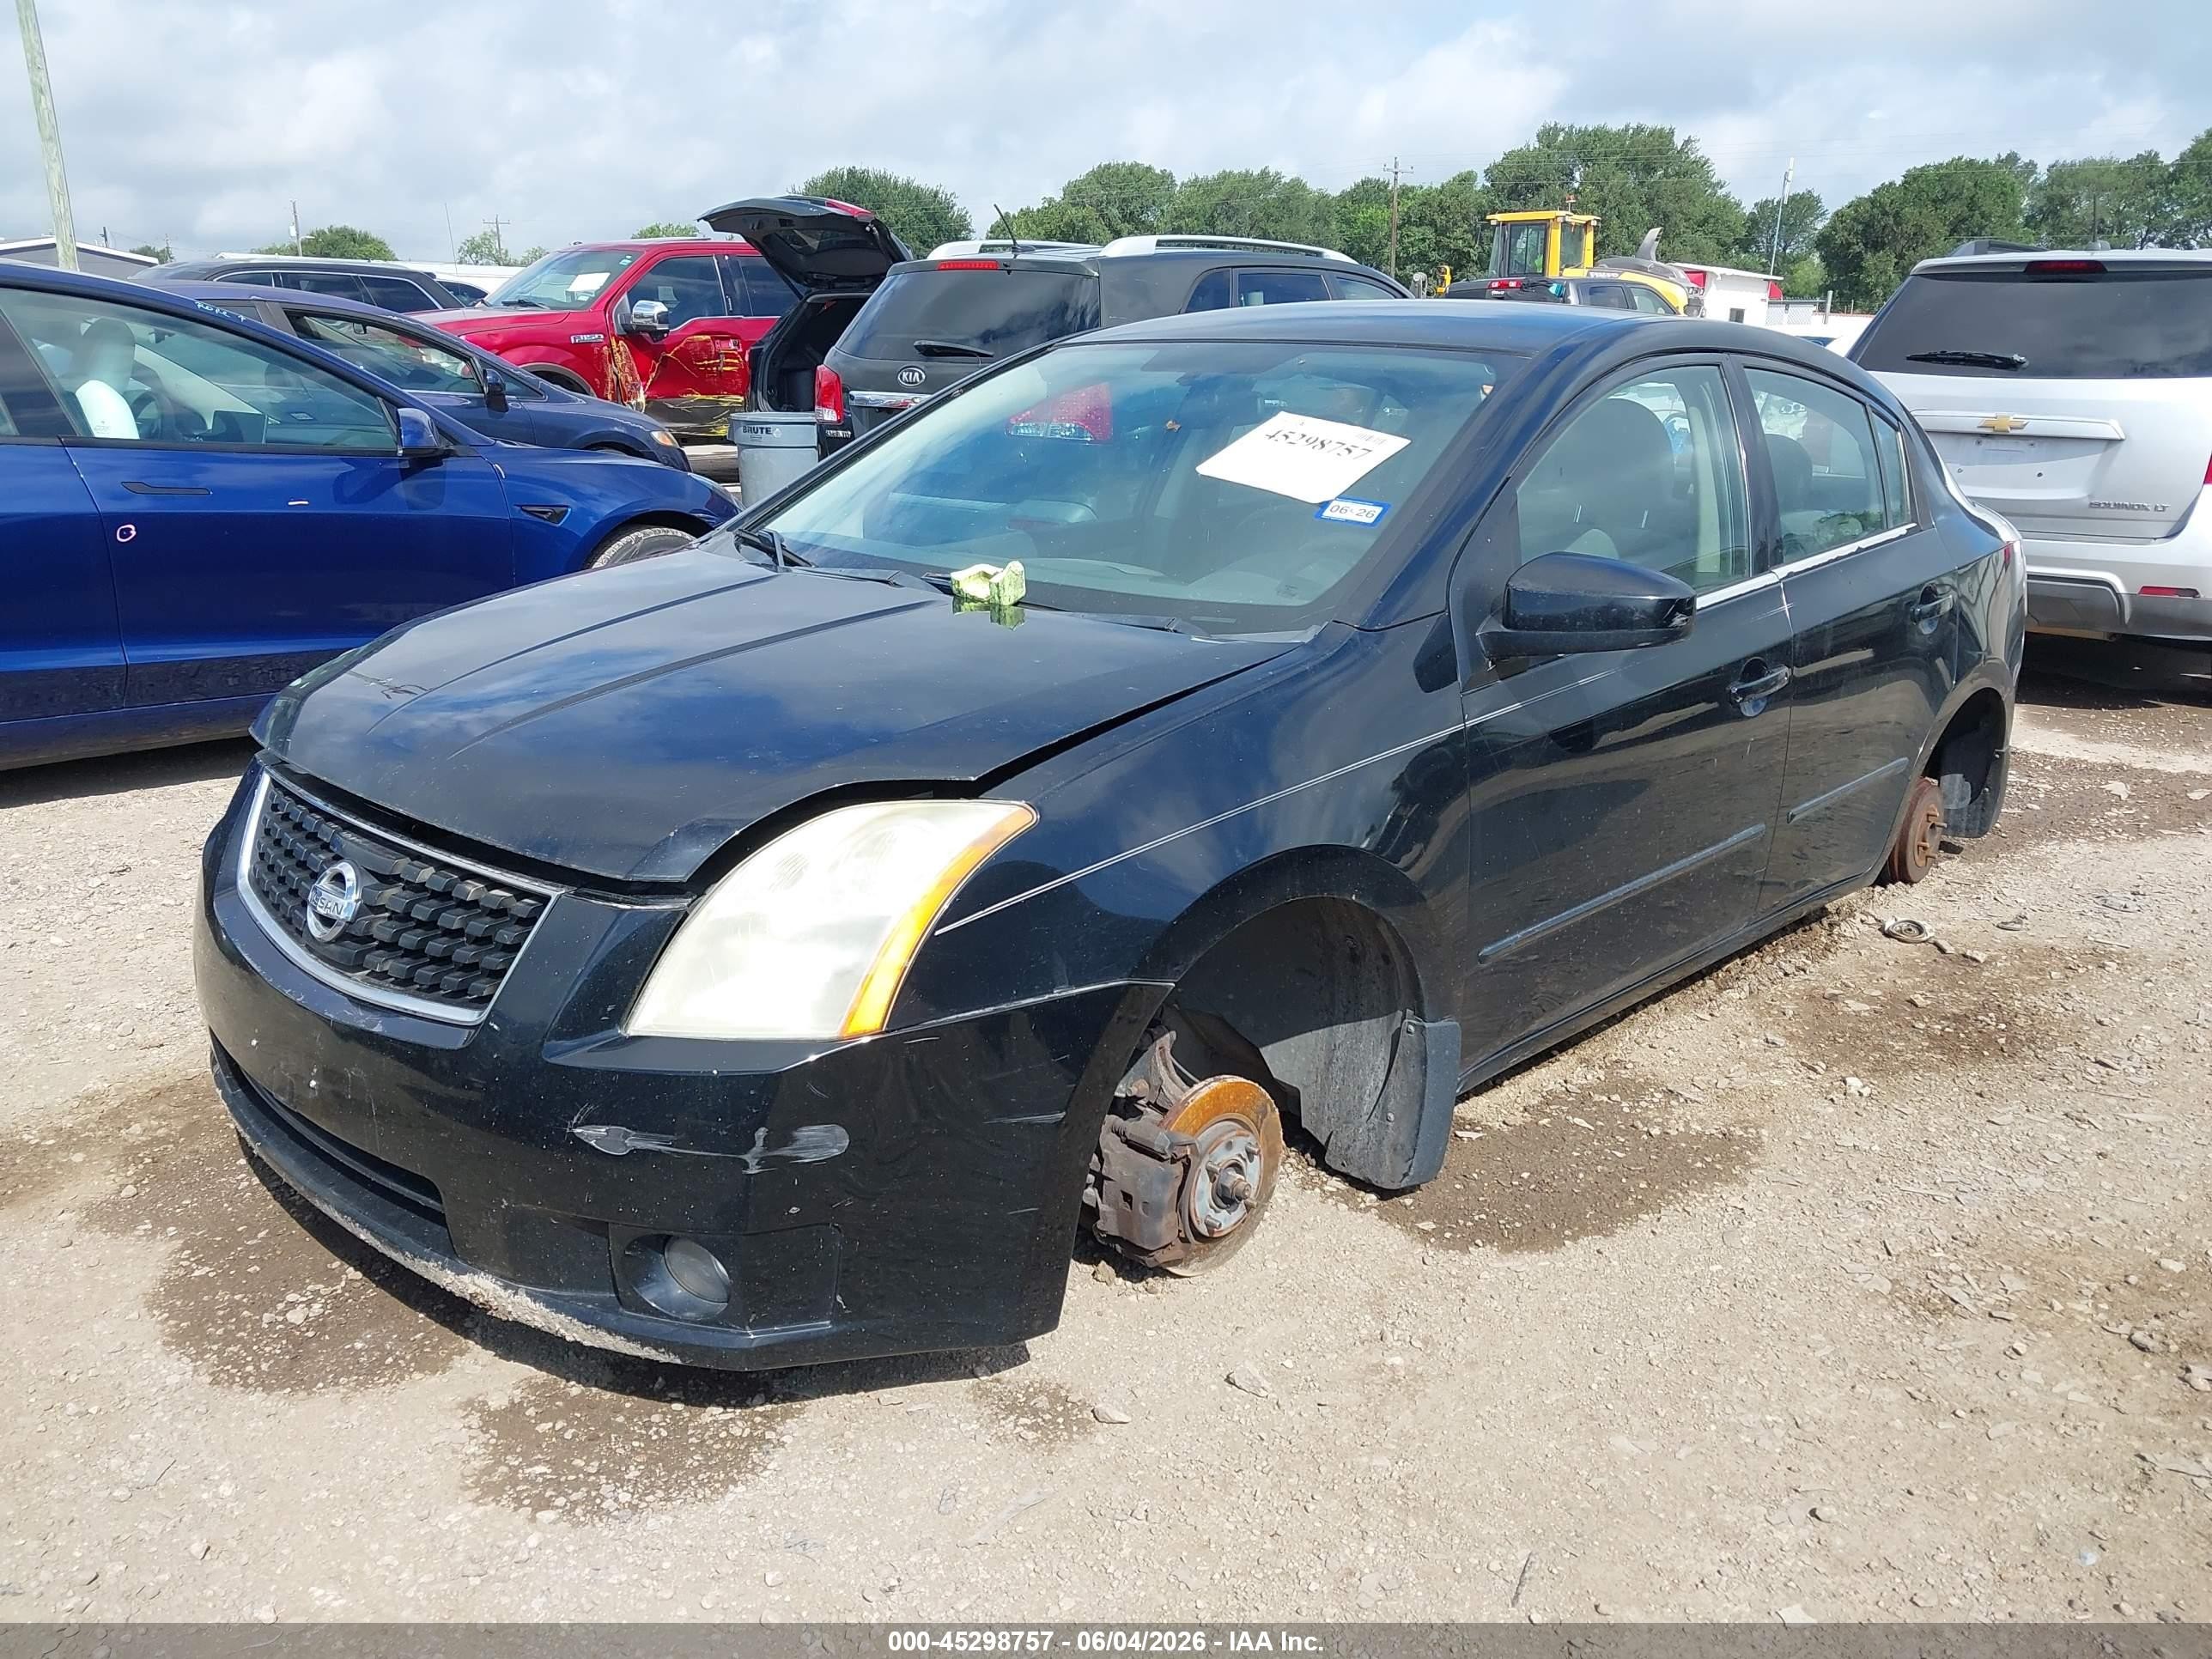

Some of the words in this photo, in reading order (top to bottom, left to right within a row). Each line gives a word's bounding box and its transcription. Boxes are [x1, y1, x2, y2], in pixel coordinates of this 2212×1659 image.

[902, 371, 920, 383] KIA
[742, 425, 773, 435] BRUTE
[1265, 429, 1374, 460] 45298757
[2088, 501, 2151, 512] EQUINOX
[2154, 503, 2172, 513] LT
